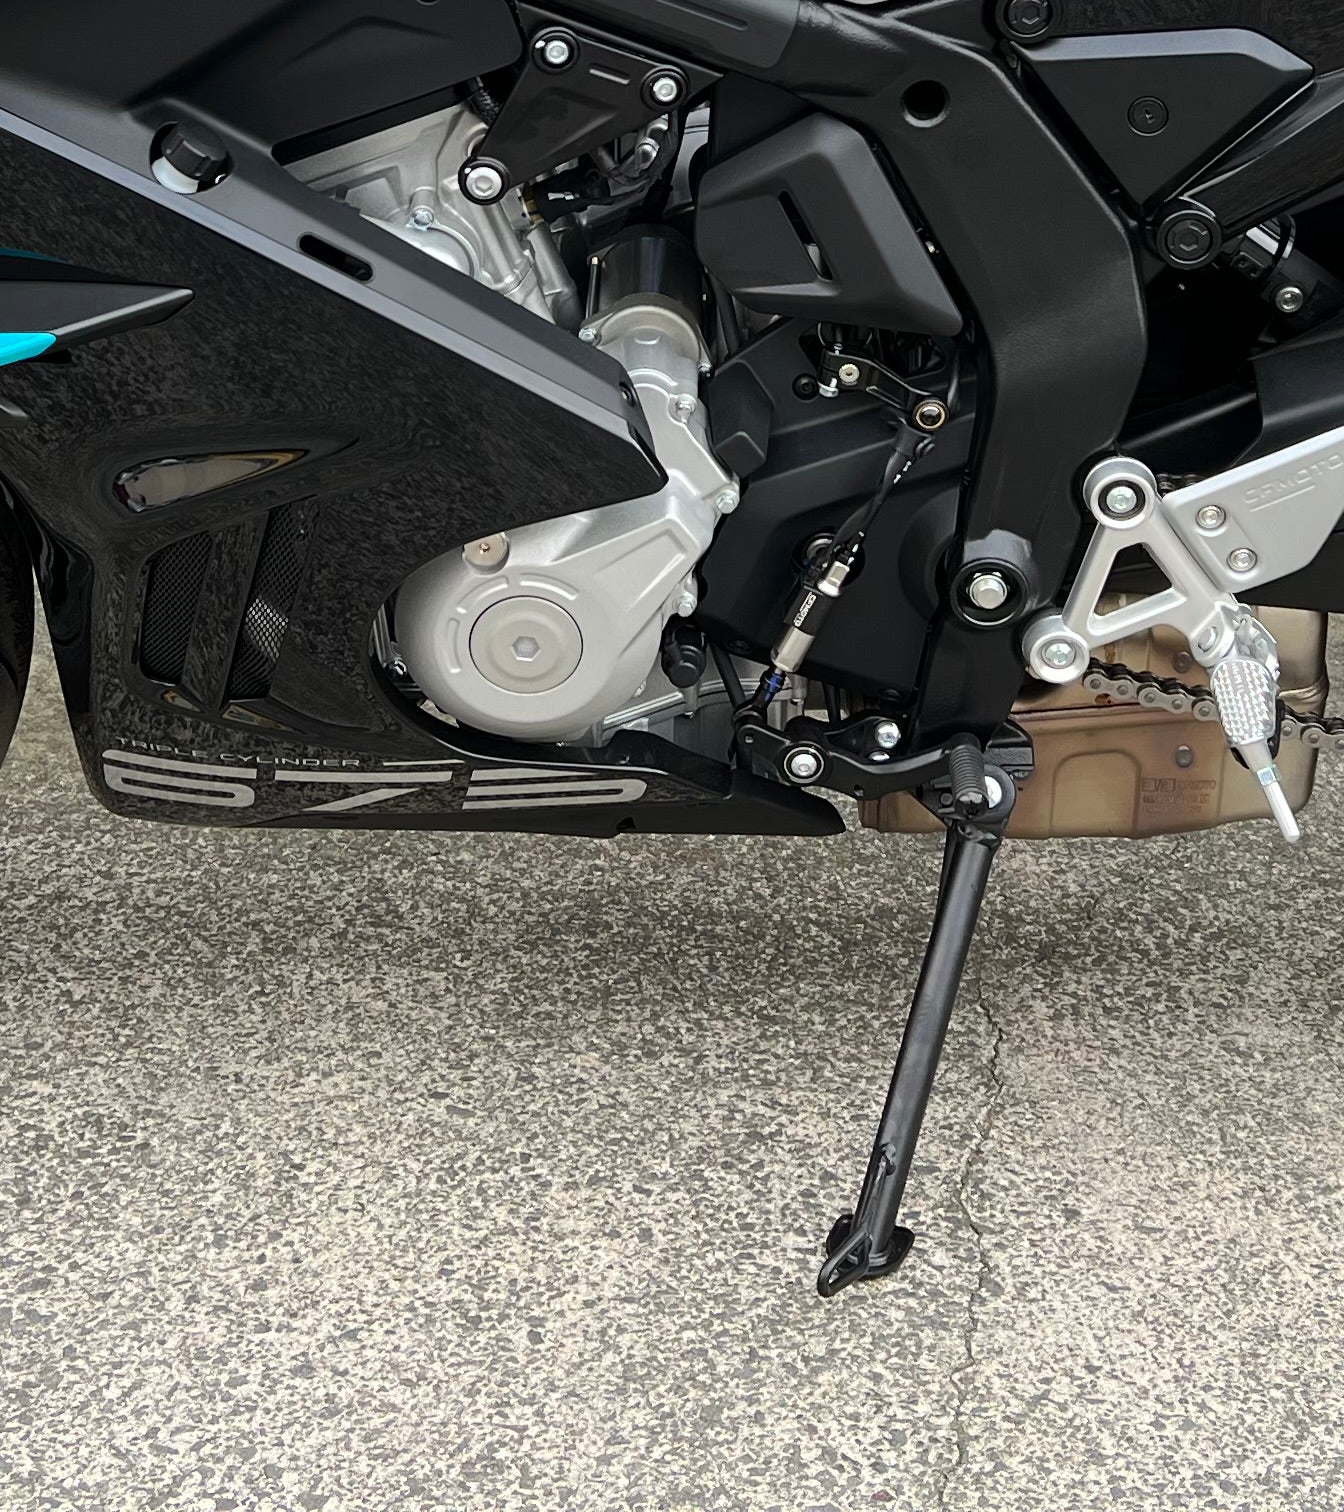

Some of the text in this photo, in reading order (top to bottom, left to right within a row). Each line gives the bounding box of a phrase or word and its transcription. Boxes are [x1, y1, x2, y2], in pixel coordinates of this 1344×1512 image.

[1244, 454, 1344, 504] CFMOTO
[116, 736, 361, 767] TRIPLE CYLINDER
[102, 748, 648, 811] 675
